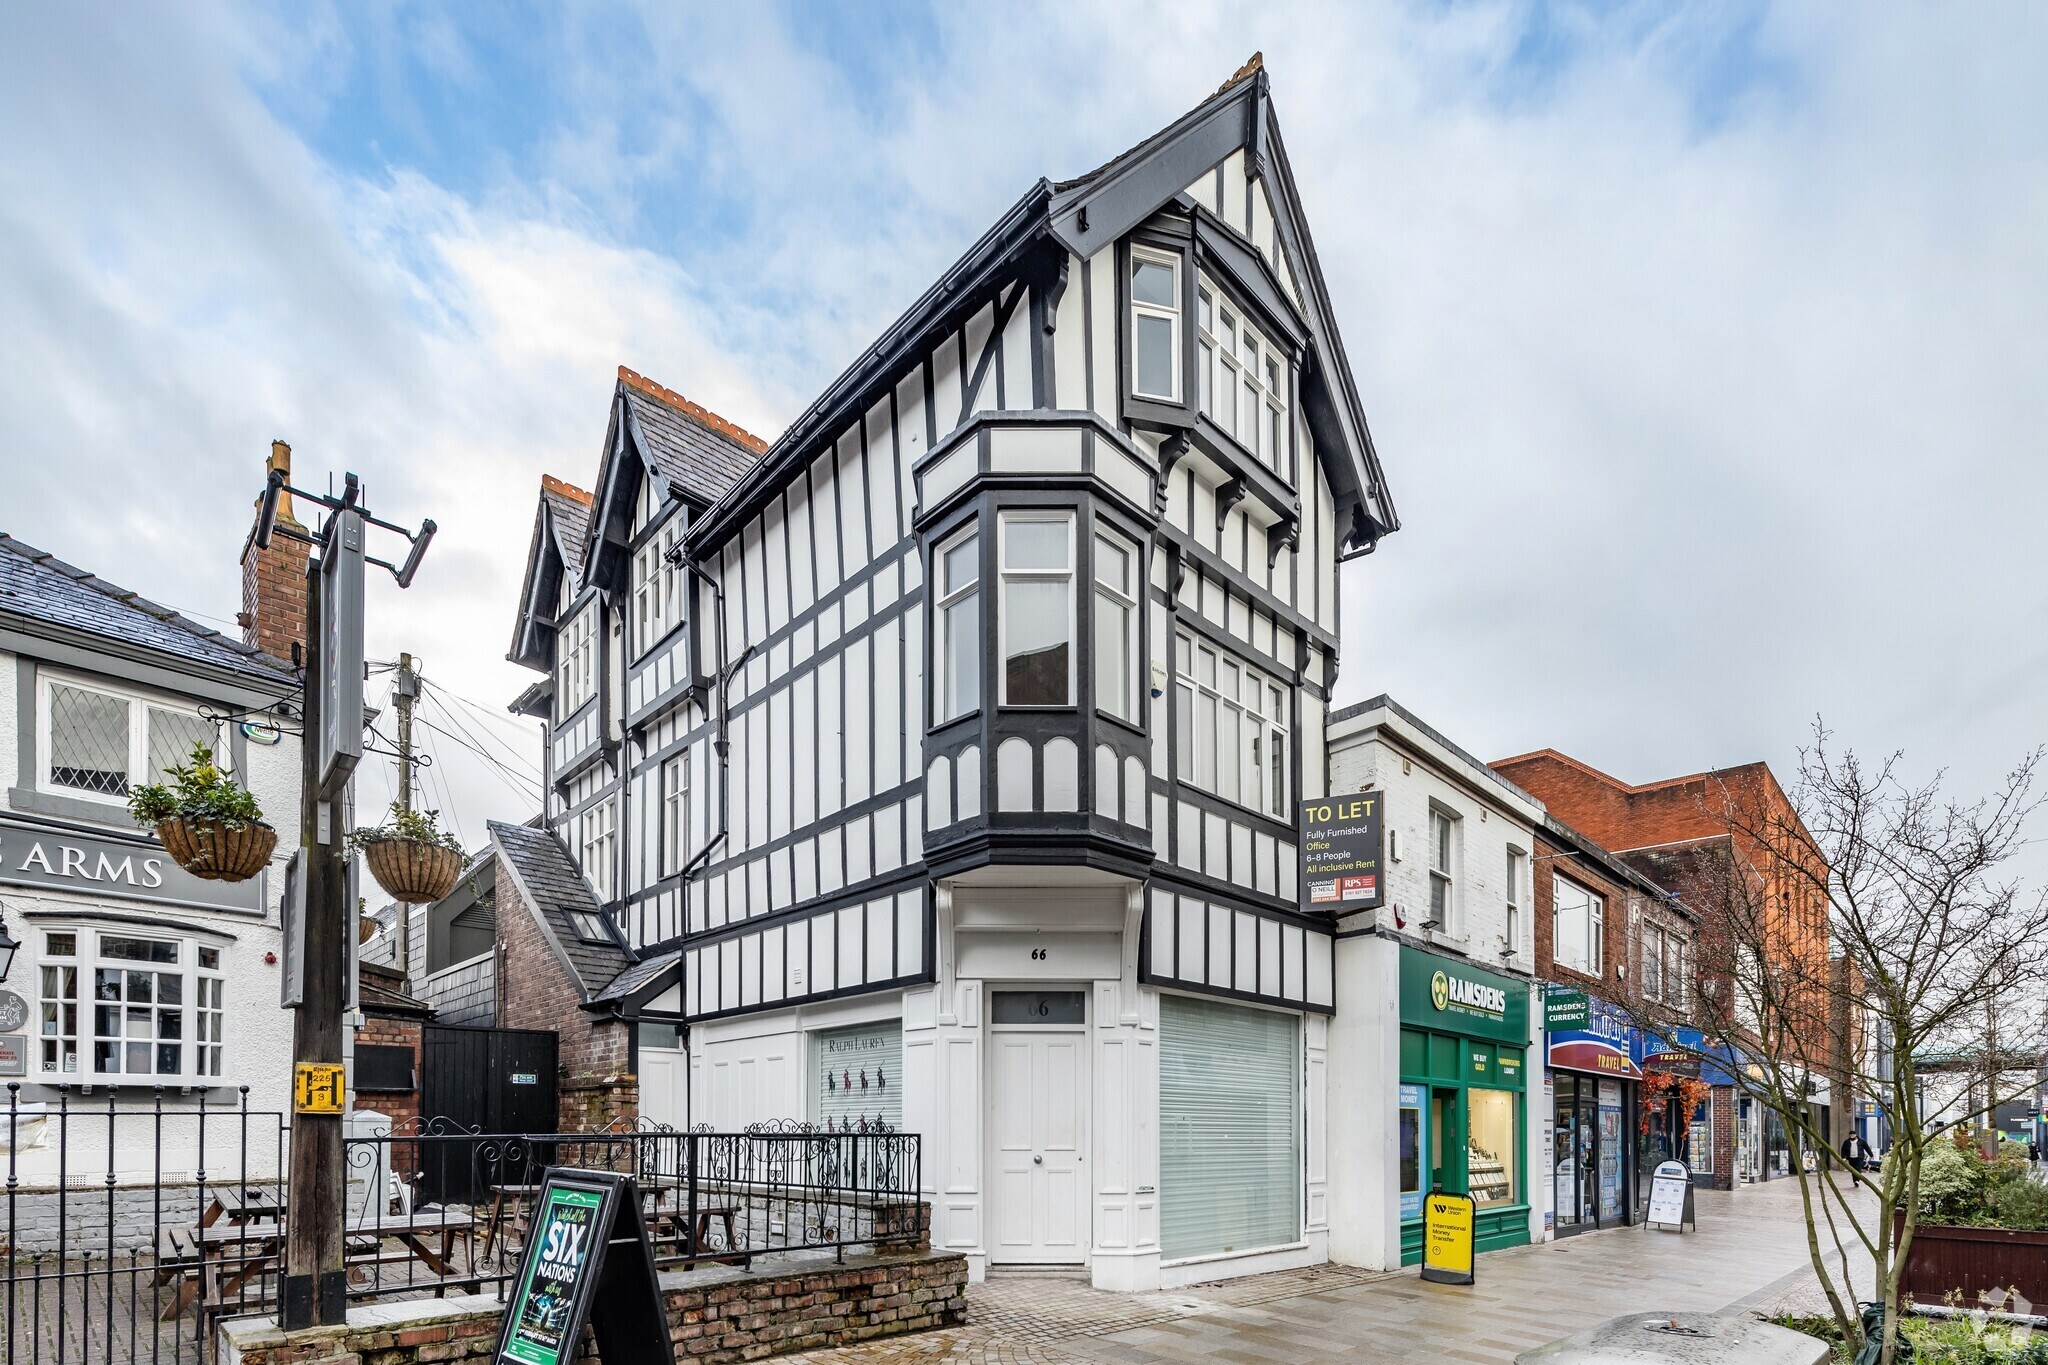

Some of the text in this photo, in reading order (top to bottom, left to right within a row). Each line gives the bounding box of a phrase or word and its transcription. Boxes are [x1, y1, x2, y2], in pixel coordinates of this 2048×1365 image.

[1305, 800, 1375, 823] TO LET
[1306, 825, 1367, 840] Fully Furnished
[1306, 841, 1330, 851] Office
[1323, 850, 1351, 861] People
[16, 841, 163, 889] ARMS
[1306, 859, 1375, 874] All inclusive Rent
[1307, 879, 1335, 887] CANNING
[1344, 878, 1362, 888] RPS
[1031, 948, 1047, 960] 66
[1448, 976, 1506, 1013] RAMSDENS
[1547, 1002, 1586, 1012] RAMSDENS
[1549, 1012, 1585, 1022] CURRENCY
[829, 1040, 853, 1053] RALPH
[1473, 1053, 1479, 1061] WE
[1659, 1053, 1688, 1061] TRAVEL
[1475, 1063, 1485, 1071] GOLD
[1597, 1054, 1620, 1071] TRAVEL
[1503, 1066, 1515, 1074] LOANS
[312, 1074, 331, 1082] 225
[1400, 1085, 1418, 1095] TRAVEL
[318, 1093, 325, 1102] 3
[1400, 1094, 1418, 1104] MONEY
[1432, 1222, 1467, 1232] International
[1432, 1229, 1451, 1237] Money
[542, 1221, 587, 1266] SIX
[536, 1261, 576, 1284] NATIONS
